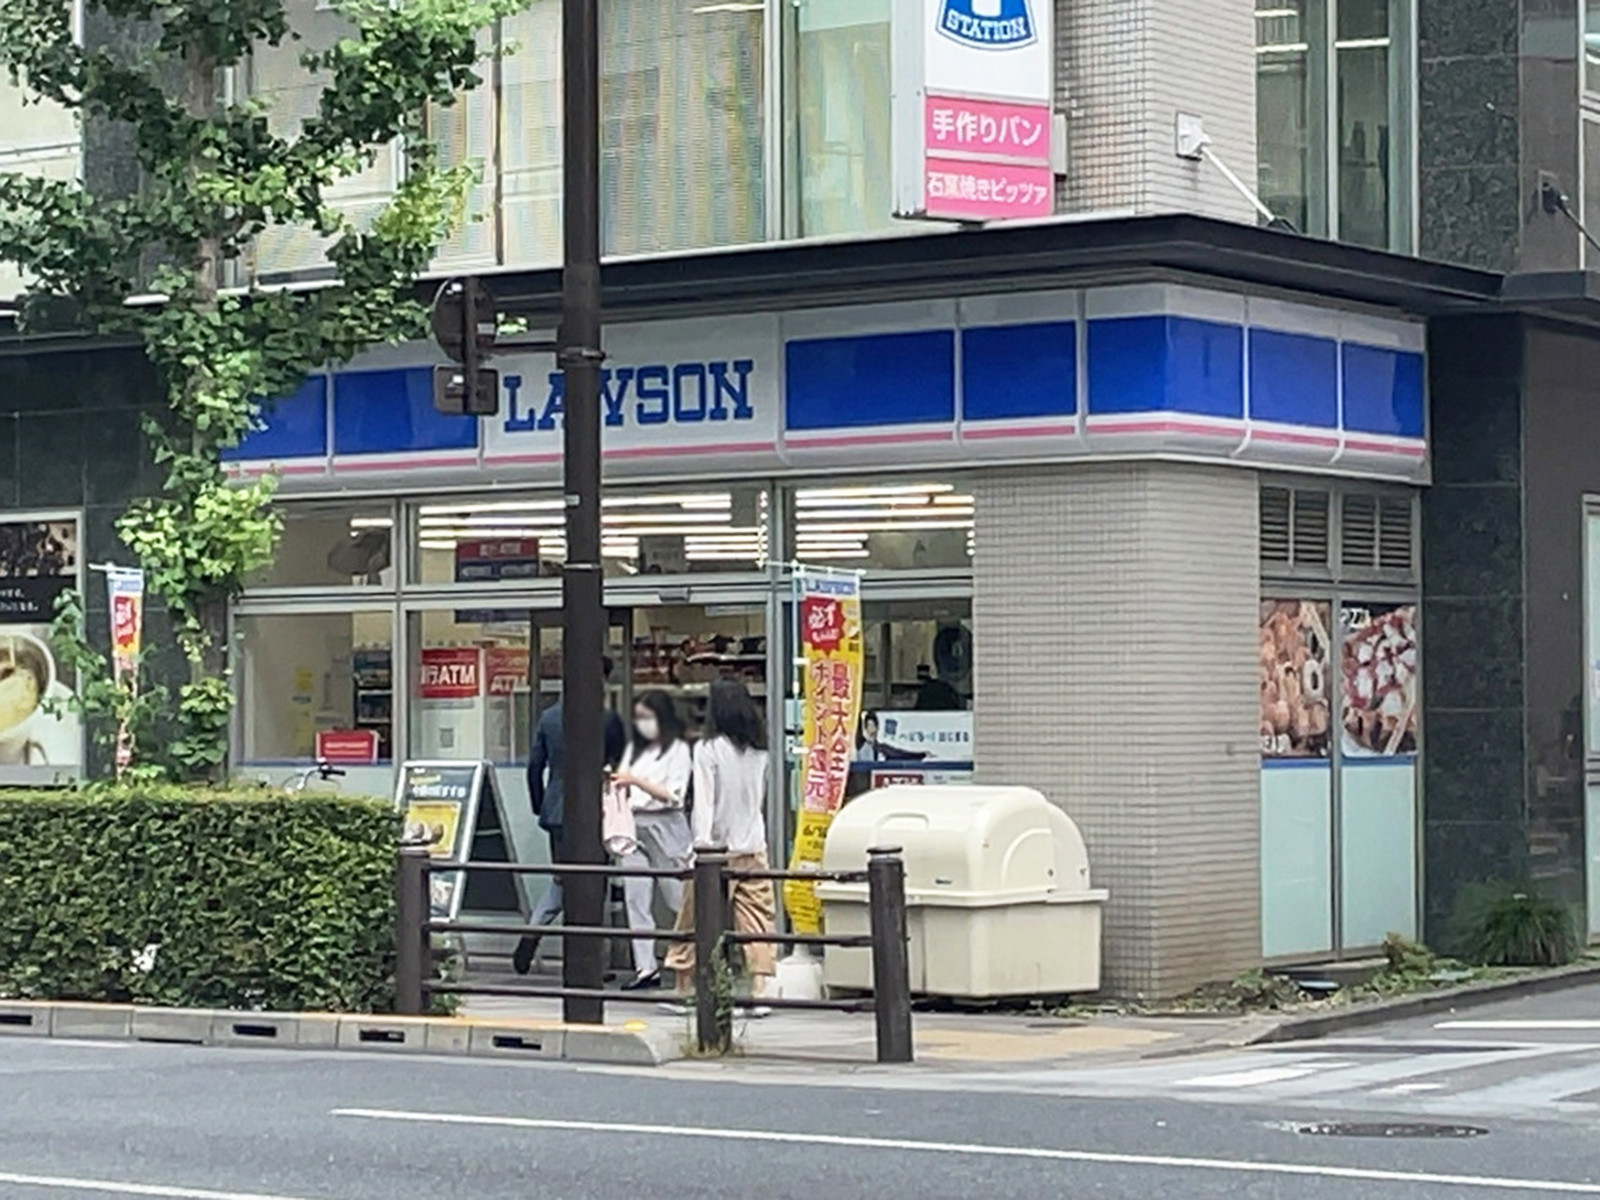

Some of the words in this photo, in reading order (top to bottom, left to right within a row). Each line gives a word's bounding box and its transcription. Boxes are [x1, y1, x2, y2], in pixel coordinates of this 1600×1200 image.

[945, 8, 1027, 41] STATION
[932, 109, 1042, 147] 手作りパン
